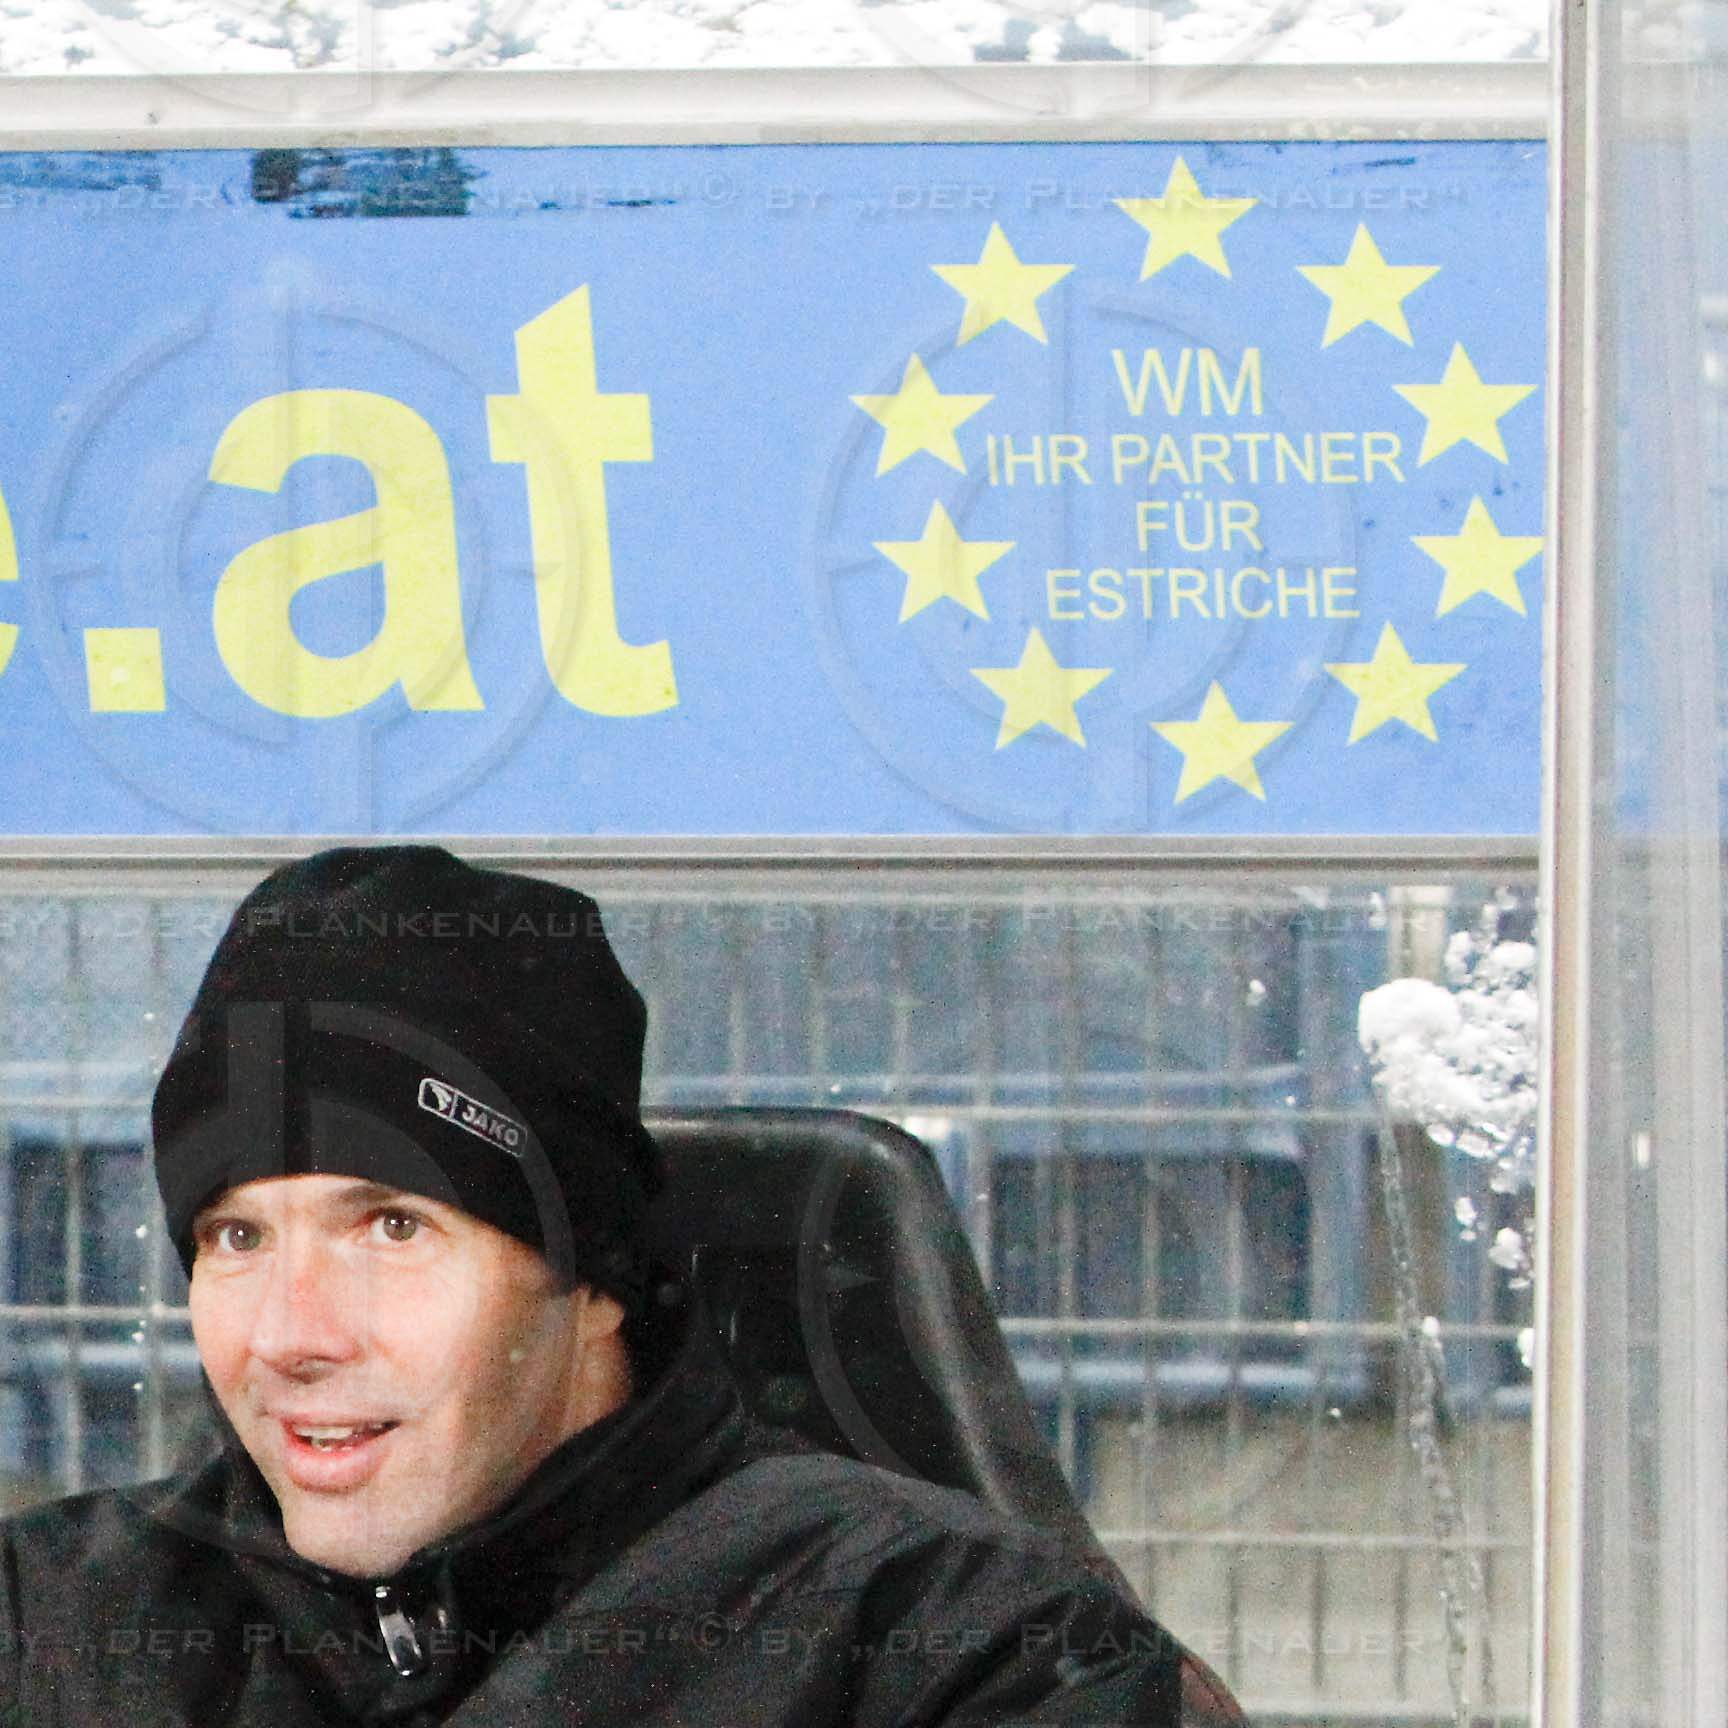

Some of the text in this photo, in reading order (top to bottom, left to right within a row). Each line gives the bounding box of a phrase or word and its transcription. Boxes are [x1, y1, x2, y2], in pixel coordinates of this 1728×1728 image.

[1111, 347, 1263, 416] WM
[986, 431, 1405, 486] IHR PARTNER
[1135, 492, 1263, 552] FÜR
[1045, 567, 1361, 621] ESTRICHE
[461, 1104, 520, 1146] JAKO
